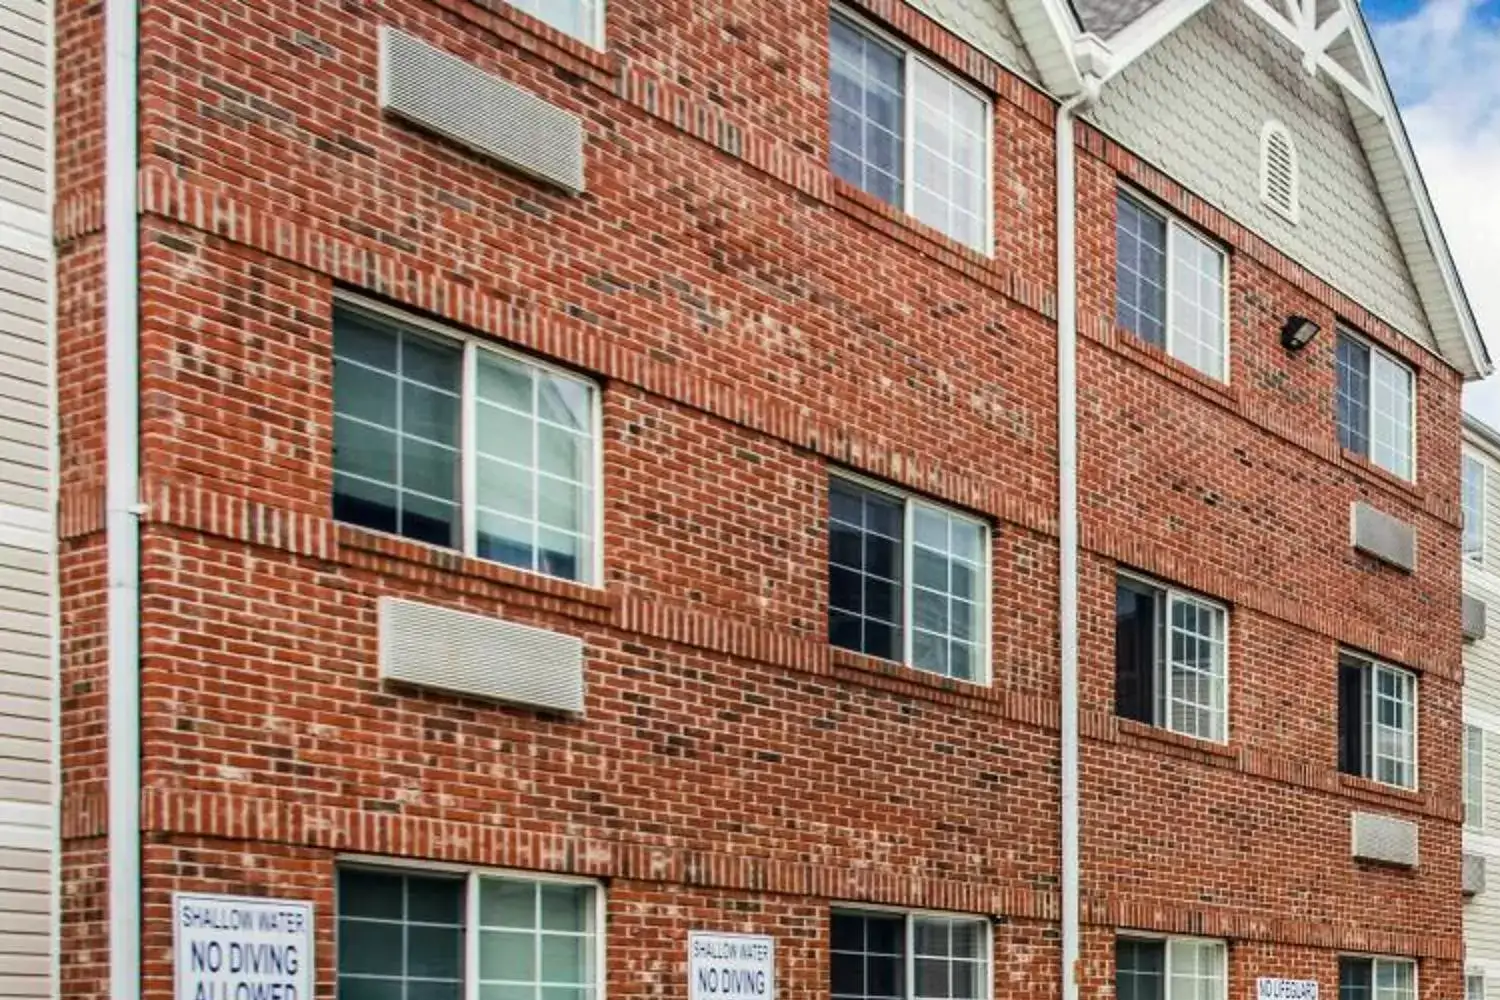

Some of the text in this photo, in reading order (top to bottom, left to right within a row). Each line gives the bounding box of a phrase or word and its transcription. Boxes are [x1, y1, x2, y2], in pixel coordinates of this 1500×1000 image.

[182, 905, 305, 932] SHALLOW WATER
[191, 941, 298, 975] NO DIVING
[693, 941, 768, 961] SHALLOW WATER
[699, 968, 764, 995] NO DIVING
[1260, 980, 1316, 1000] NO LIFEGUARD
